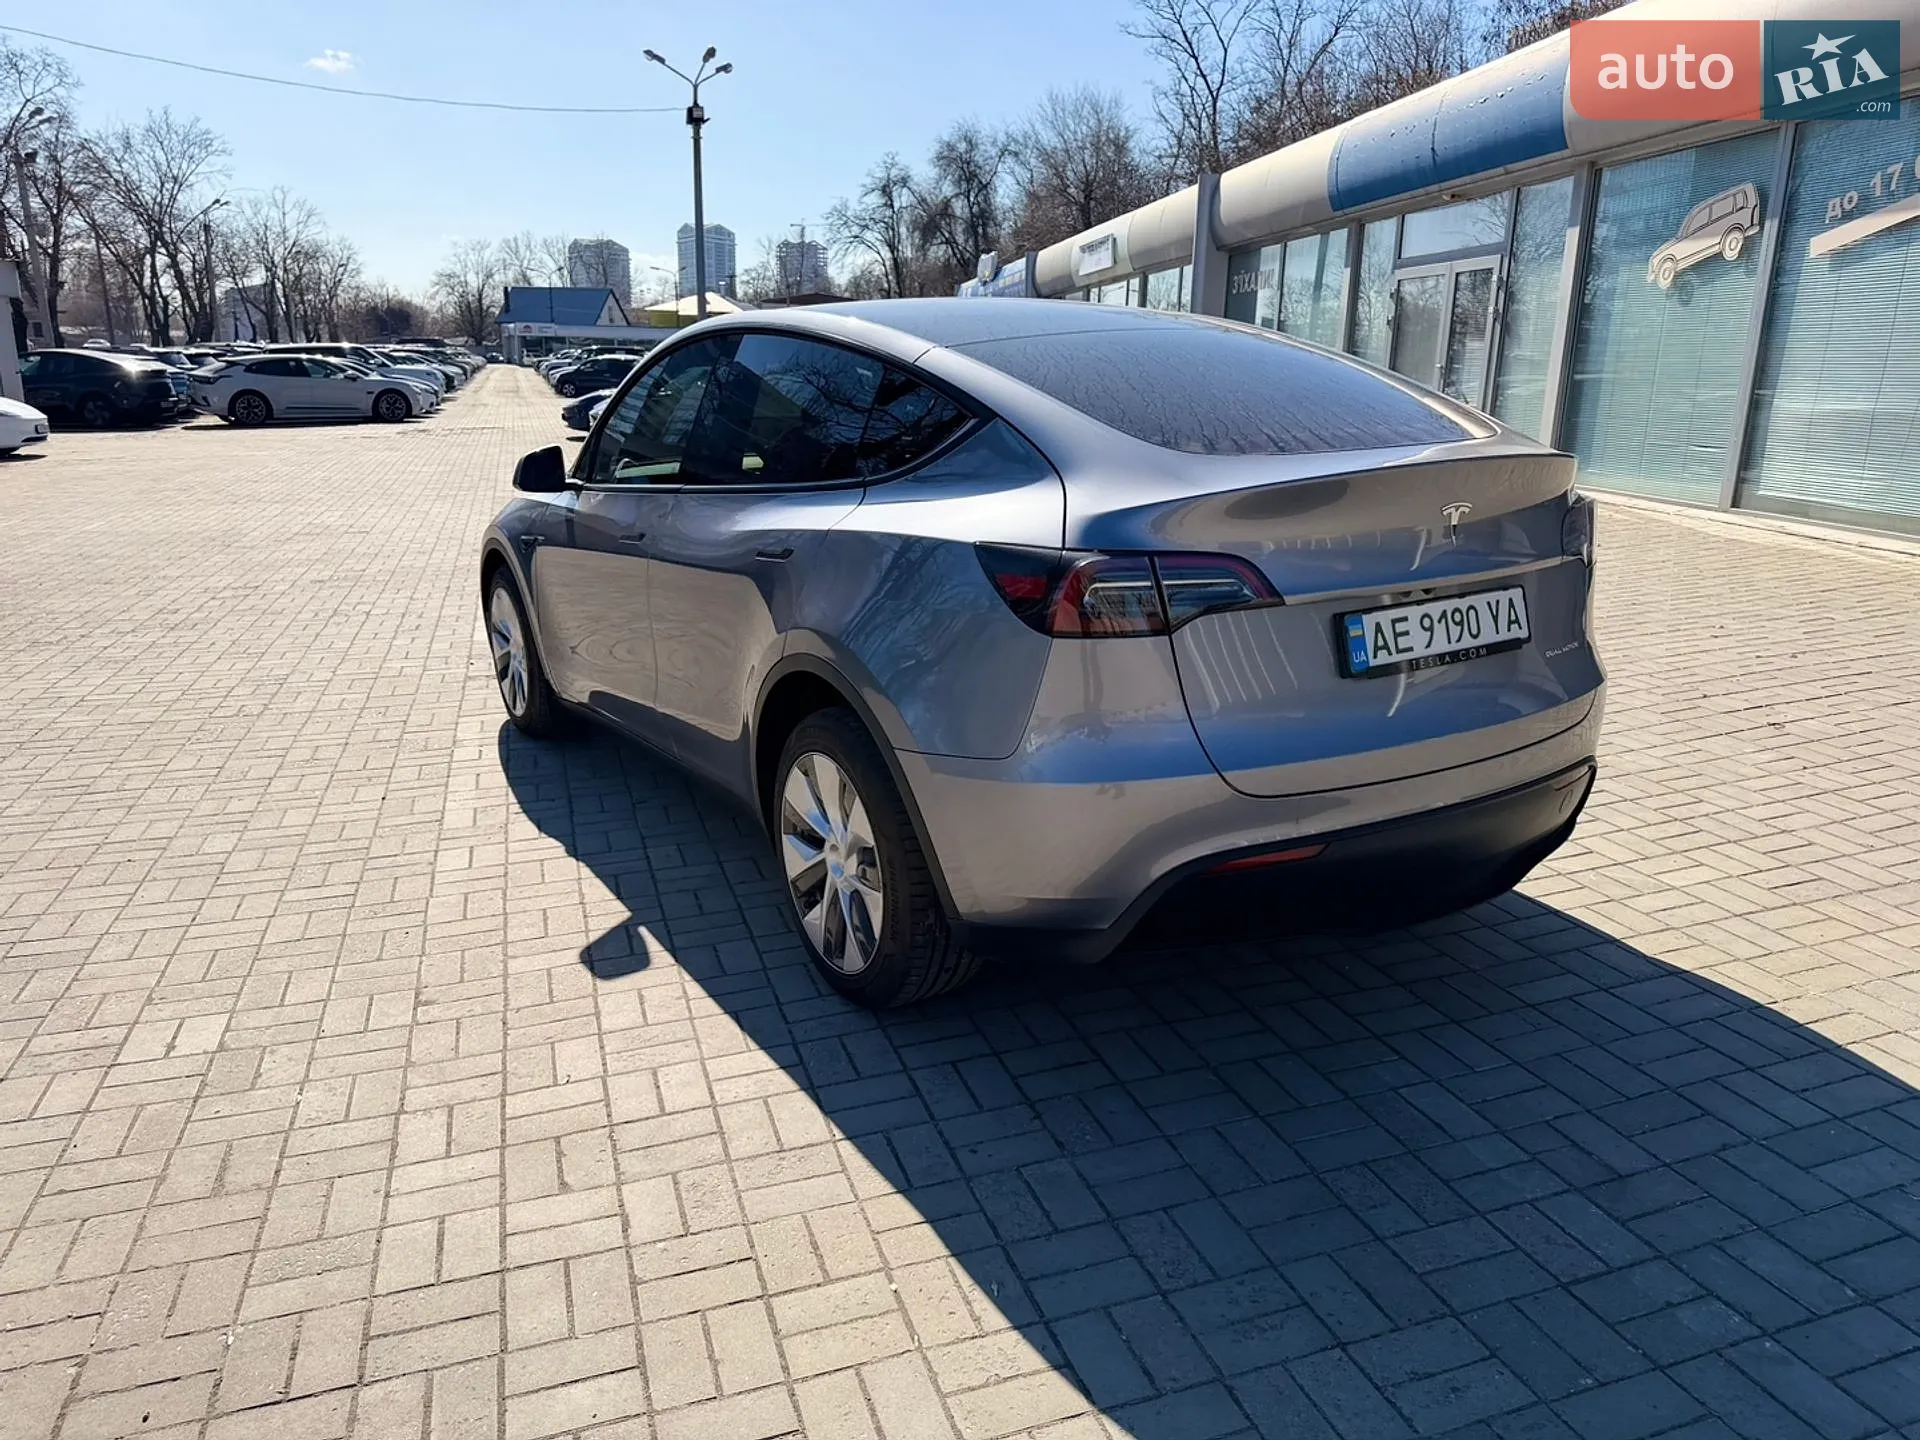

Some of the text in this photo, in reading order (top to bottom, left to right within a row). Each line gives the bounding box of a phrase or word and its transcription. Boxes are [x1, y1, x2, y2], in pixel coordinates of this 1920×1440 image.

[1825, 190, 1859, 224] до
[1870, 161, 1904, 197] 17
[1353, 650, 1367, 663] UA
[1373, 597, 1522, 659] AE 9190 YA
